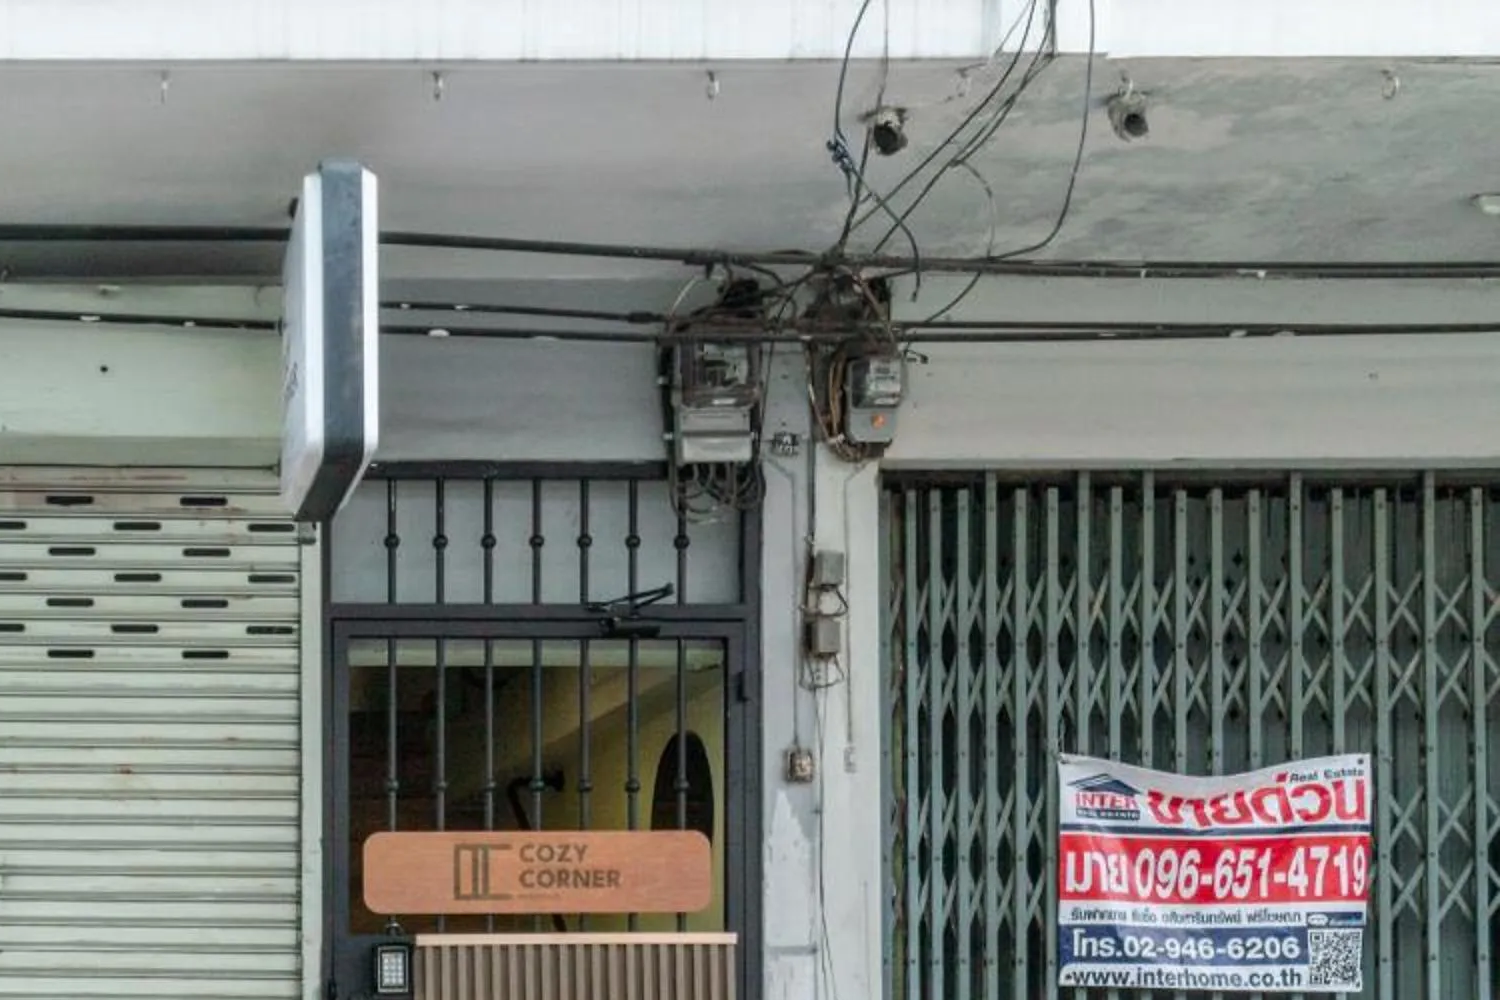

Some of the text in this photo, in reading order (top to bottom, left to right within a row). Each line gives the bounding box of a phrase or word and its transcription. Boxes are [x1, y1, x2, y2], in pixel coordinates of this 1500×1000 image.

[1148, 772, 1365, 827] ขายด่วน
[519, 844, 588, 863] COZY
[519, 869, 621, 889] CORNER
[1135, 845, 1366, 899] 096-651-4719
[1074, 966, 1301, 987] www.interhome.co.th
